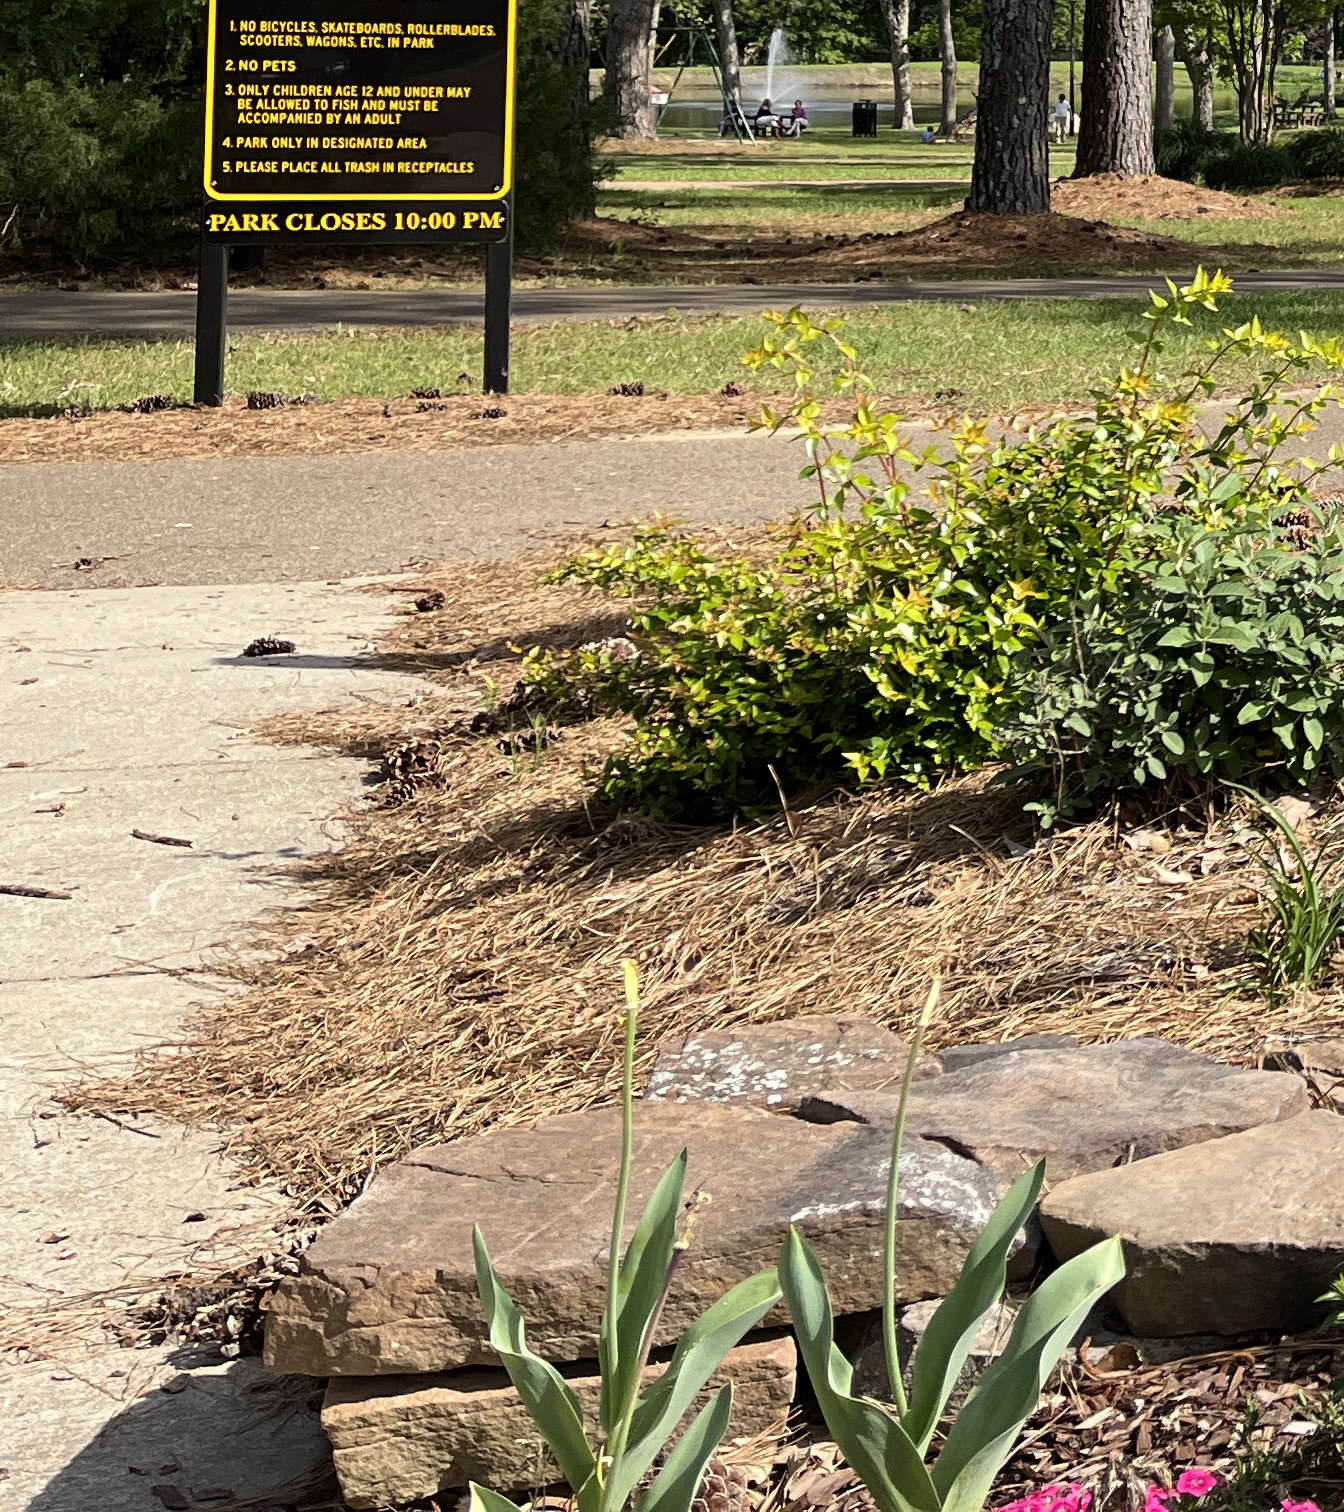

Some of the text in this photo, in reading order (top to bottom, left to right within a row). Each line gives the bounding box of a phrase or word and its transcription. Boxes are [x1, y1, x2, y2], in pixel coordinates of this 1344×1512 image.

[230, 20, 237, 31] 1.
[240, 20, 256, 32] NO
[361, 36, 384, 48] ETC.
[388, 37, 400, 48] IN
[403, 37, 434, 48] PARK
[225, 59, 296, 72] 2. NO PETS
[225, 84, 472, 98] 3. ONLY CHILDREN AGE 12 AND UNDER MAY
[238, 98, 438, 111] BE ALLOWED TO FISH AND MUST BE
[238, 112, 401, 124] ACCOMPANIED BY AN ADULT
[222, 137, 427, 149] 4. PARK ONLY IN DESIGNATED AREA
[223, 161, 474, 173] 5. PLEASE PLACE ALL TRASH IN RECEPTACLES
[209, 212, 501, 232] PARK CLOSES 10:00 PM
